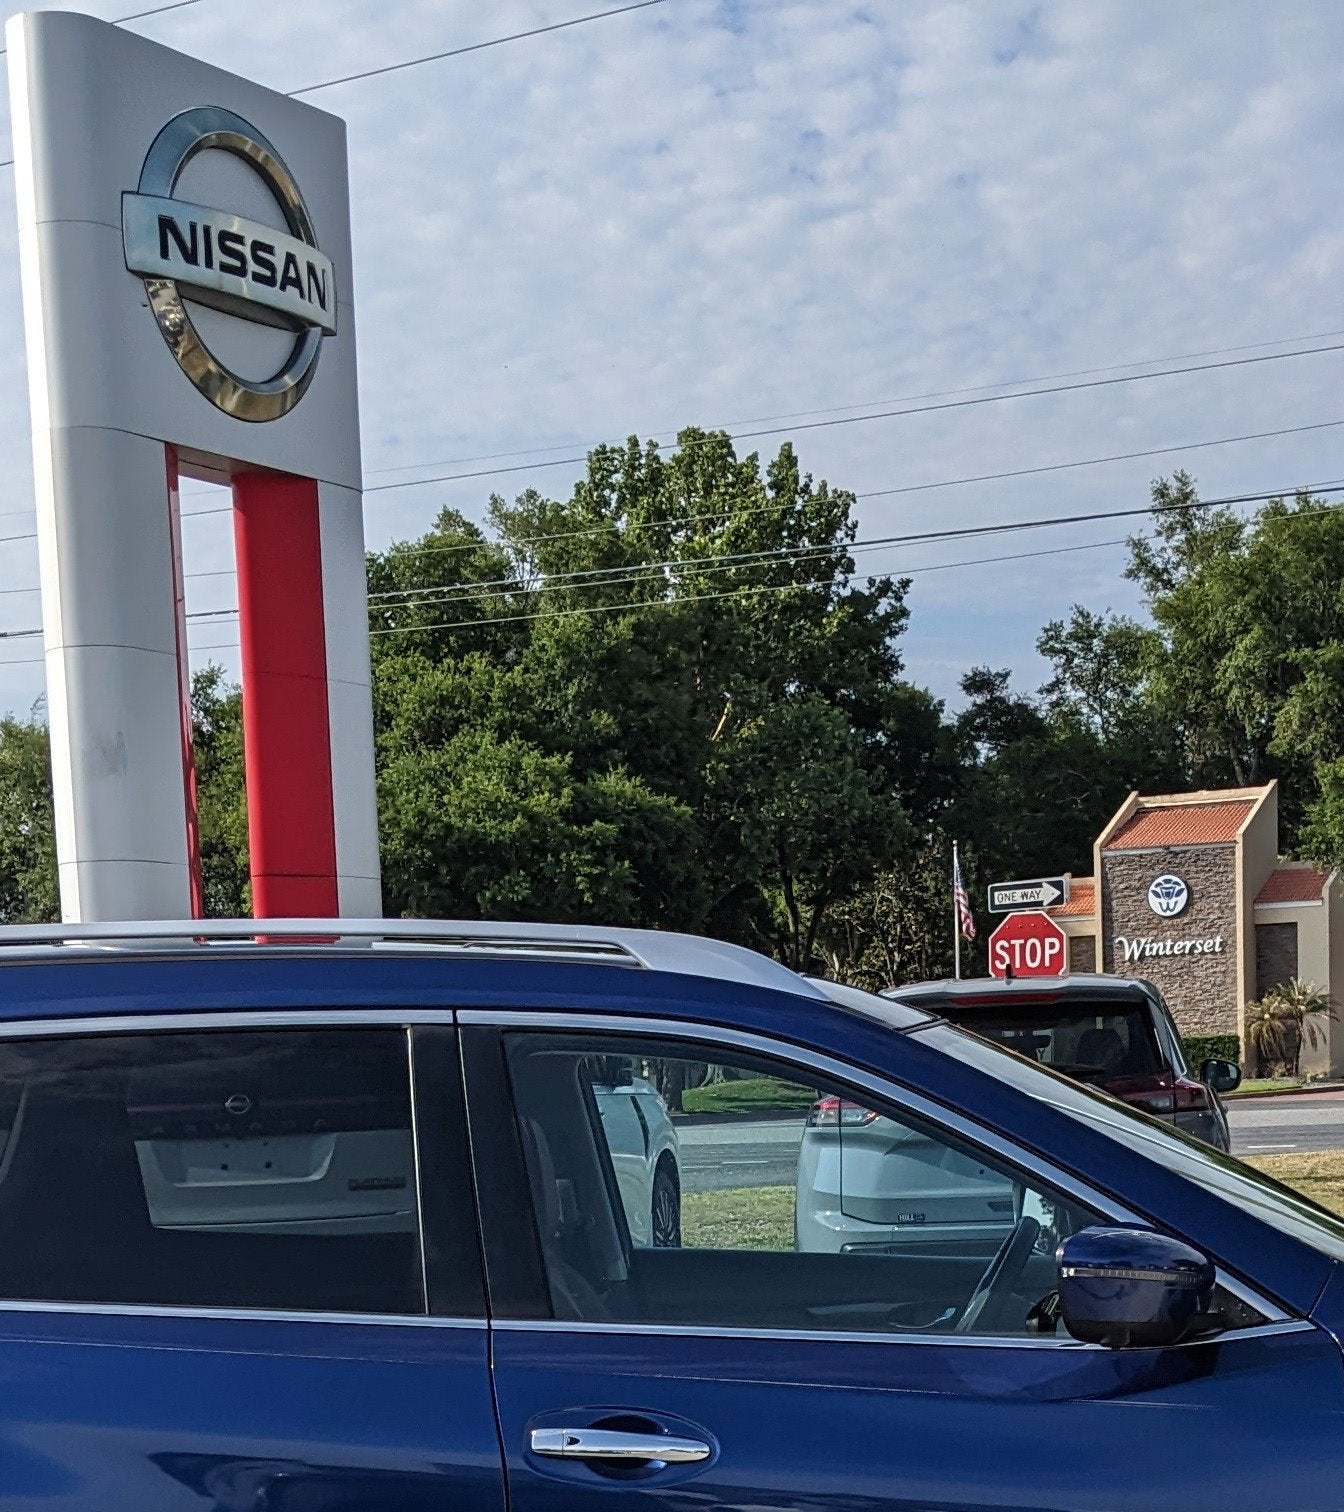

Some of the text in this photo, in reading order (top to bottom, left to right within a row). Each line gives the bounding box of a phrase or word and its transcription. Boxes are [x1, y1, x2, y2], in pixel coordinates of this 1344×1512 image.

[157, 215, 327, 312] NISSAN
[997, 889, 1042, 903] ONE WAY
[994, 937, 1061, 970] STOP
[1115, 935, 1224, 961] Winterset
